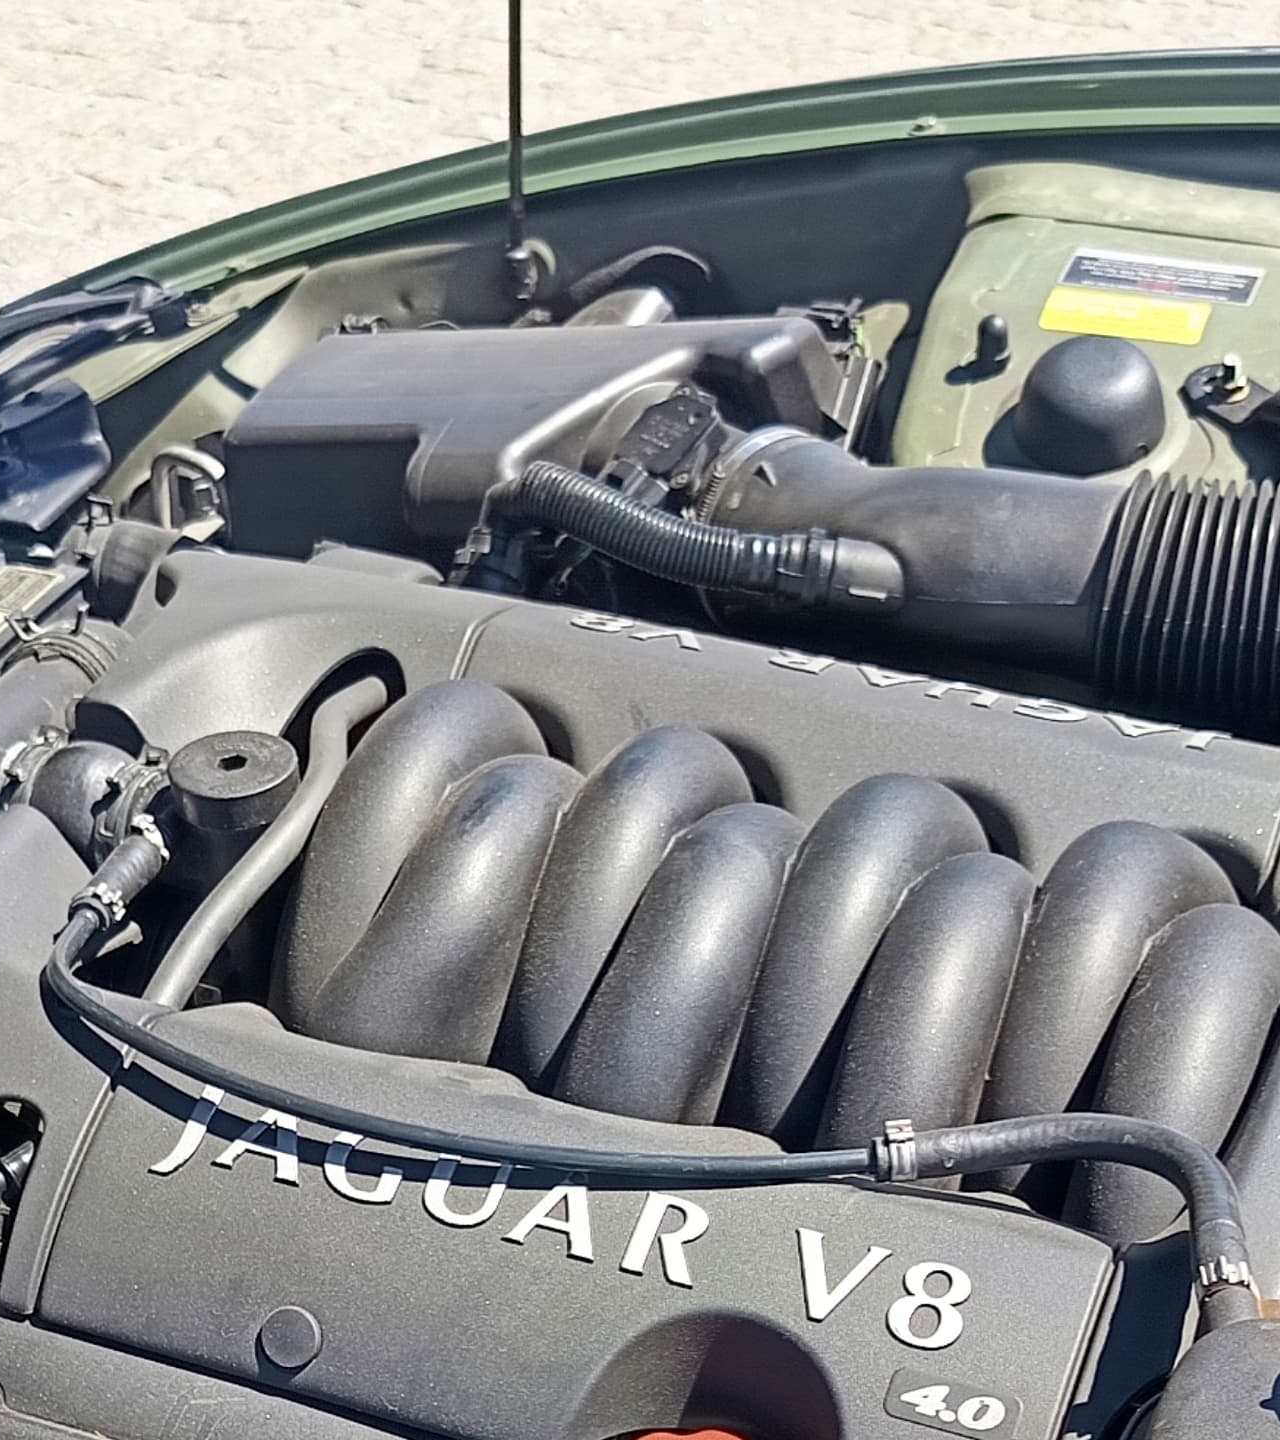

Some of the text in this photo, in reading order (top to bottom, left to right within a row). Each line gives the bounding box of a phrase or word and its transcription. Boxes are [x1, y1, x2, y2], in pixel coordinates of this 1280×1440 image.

[570, 610, 1231, 751] JAGUAR V8
[149, 1084, 972, 1351] JAGUAR V8
[898, 1381, 1005, 1432] 4.0
